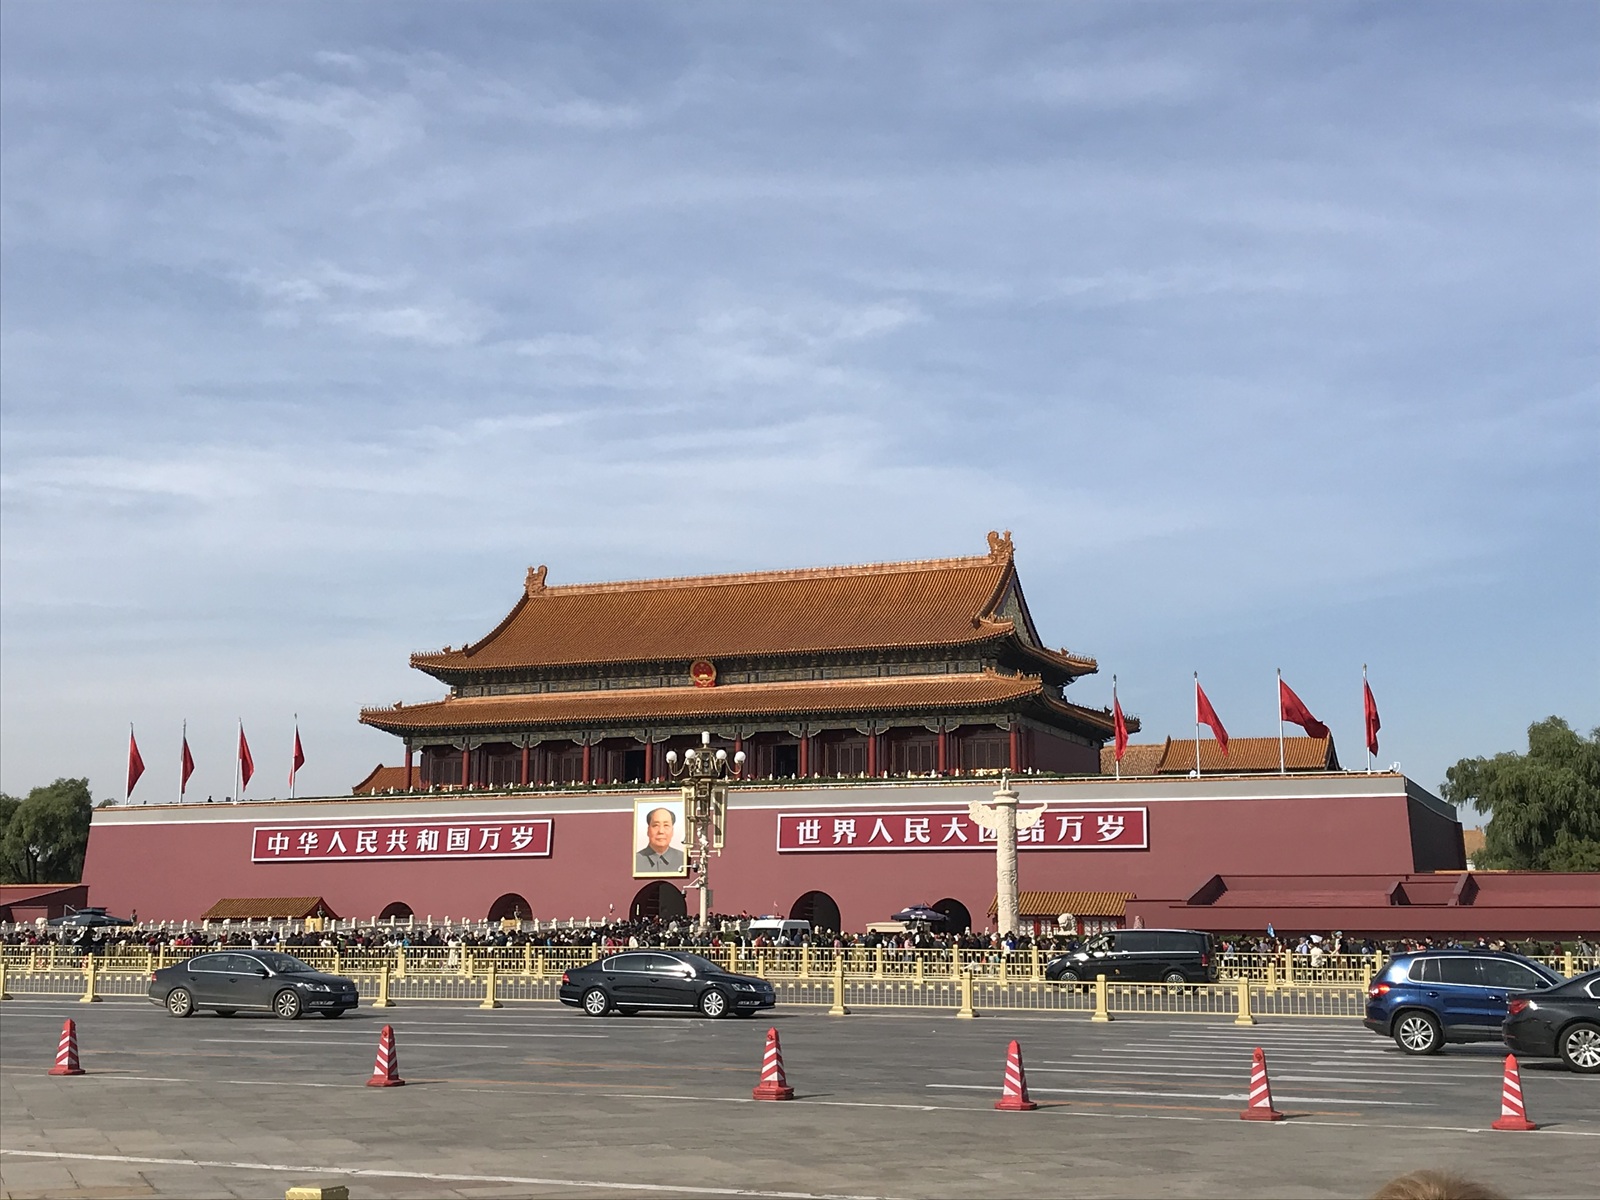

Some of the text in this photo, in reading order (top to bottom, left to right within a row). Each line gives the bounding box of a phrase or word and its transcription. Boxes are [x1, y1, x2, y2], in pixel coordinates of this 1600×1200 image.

[267, 826, 534, 855] 中华人民共和国万岁
